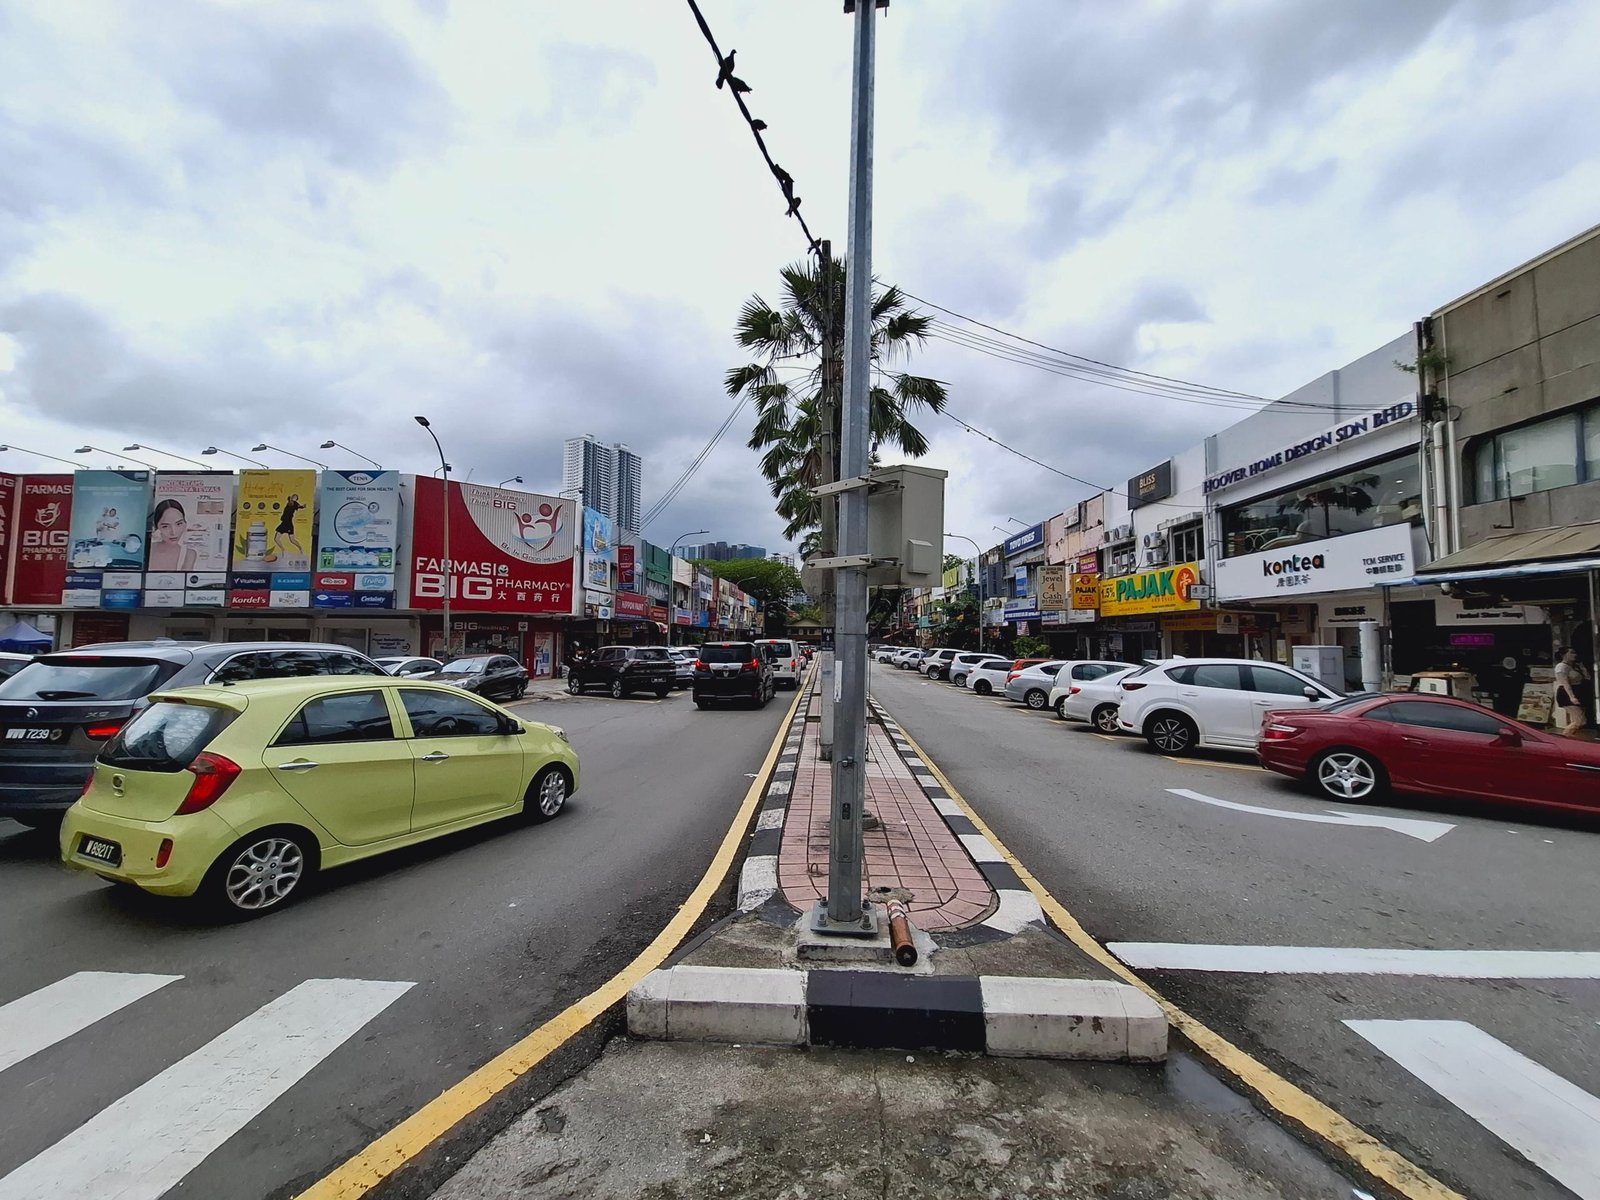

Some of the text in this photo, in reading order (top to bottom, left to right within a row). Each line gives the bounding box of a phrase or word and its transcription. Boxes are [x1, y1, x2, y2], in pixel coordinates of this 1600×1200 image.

[1204, 402, 1413, 494] HOOVER HOME DESIGN SDN BHD
[1139, 473, 1156, 489] BLISS
[25, 484, 72, 495] FARMAS
[493, 500, 516, 510] BIG
[22, 530, 69, 546] BIG
[1263, 553, 1325, 577] kontea
[1362, 553, 1406, 566] TCM SERVICE
[416, 556, 497, 577] FARMASI
[1041, 575, 1063, 585] Jewel
[1101, 586, 1116, 600] 1.5%
[1115, 570, 1177, 602] PAJAK
[415, 573, 565, 600] BIG PHARMACY
[1047, 582, 1056, 592] 4
[1075, 586, 1097, 594] PAJAK
[231, 596, 266, 604] Kordel's
[497, 590, 561, 603] 大西药行
[1042, 592, 1063, 600] Cash
[454, 621, 478, 630] BIG
[26, 728, 50, 739] 7239
